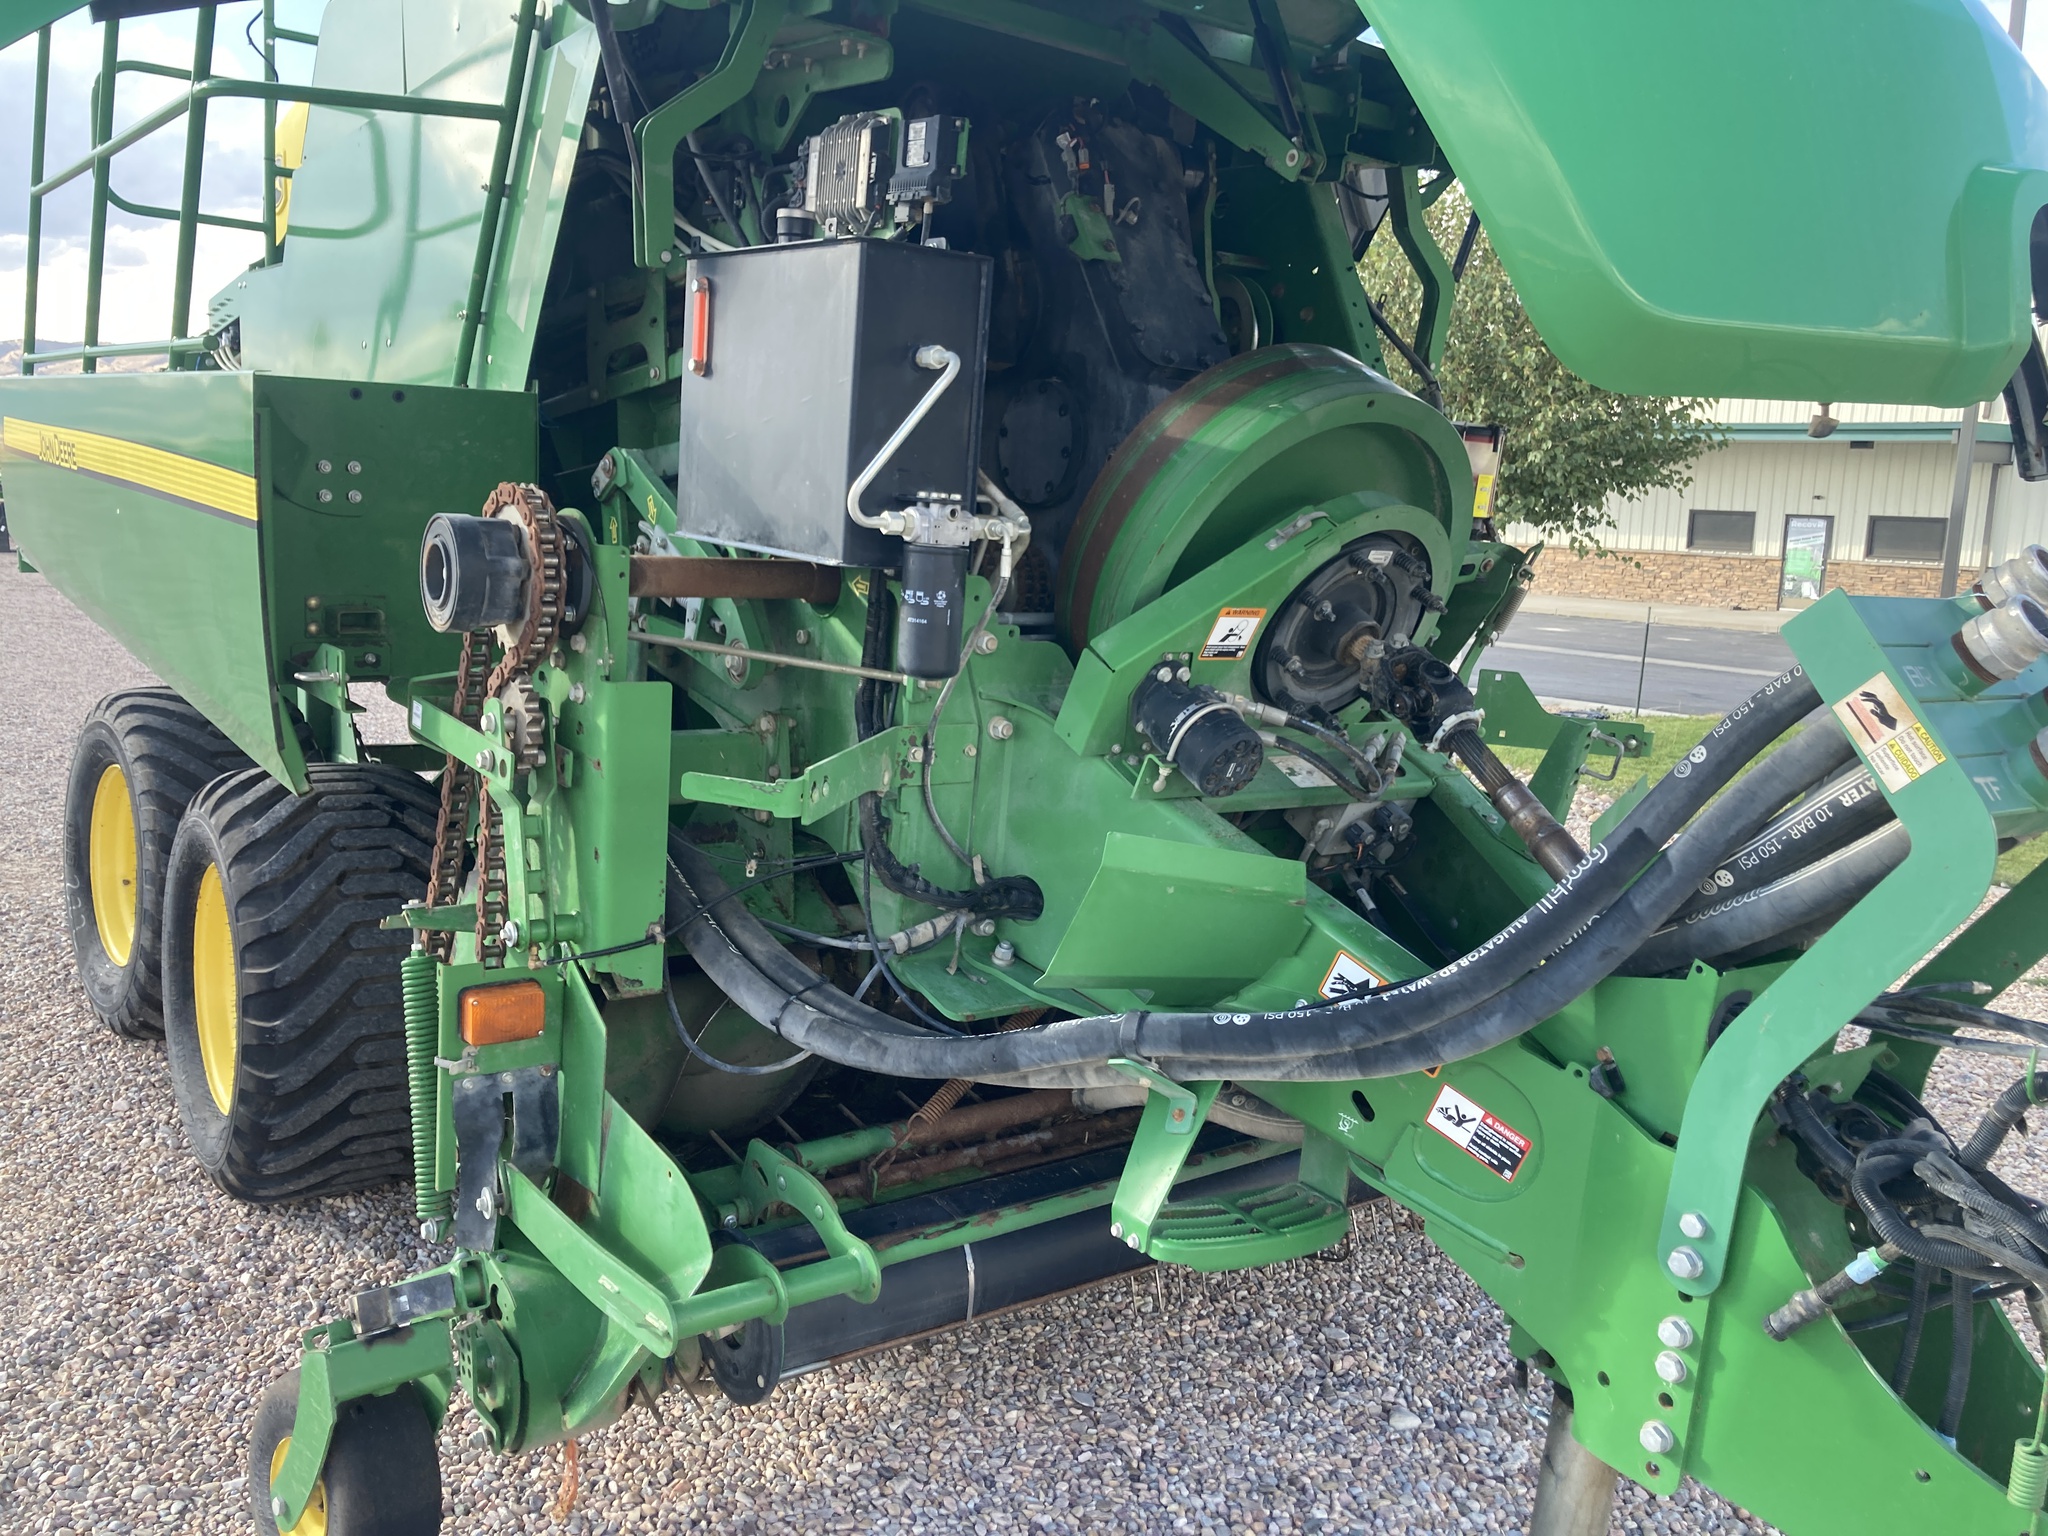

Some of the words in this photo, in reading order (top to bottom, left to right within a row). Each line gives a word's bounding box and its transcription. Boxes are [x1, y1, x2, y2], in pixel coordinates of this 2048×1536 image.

[39, 431, 55, 461] JOHN
[54, 434, 77, 467] DEERE
[1764, 672, 1792, 696] BAR
[1732, 698, 1755, 720] 150
[1712, 718, 1732, 738] PSI
[1898, 735, 1905, 745] Do
[1903, 743, 1912, 753] not
[1910, 752, 1923, 768] touch
[1905, 730, 1914, 740] Hot
[1912, 740, 1928, 760] surface
[1919, 732, 1943, 761] CAUTION
[1894, 748, 1918, 779] CUIDADO
[1838, 777, 1878, 808] ATER
[1815, 804, 1833, 823] 10
[1787, 815, 1817, 840] BAR
[1737, 851, 1760, 871] PSI
[1758, 840, 1782, 859] 150
[1459, 914, 1529, 968] ALLIGATOR
[1439, 965, 1459, 978] SD
[1493, 1122, 1526, 1148] DANGER
